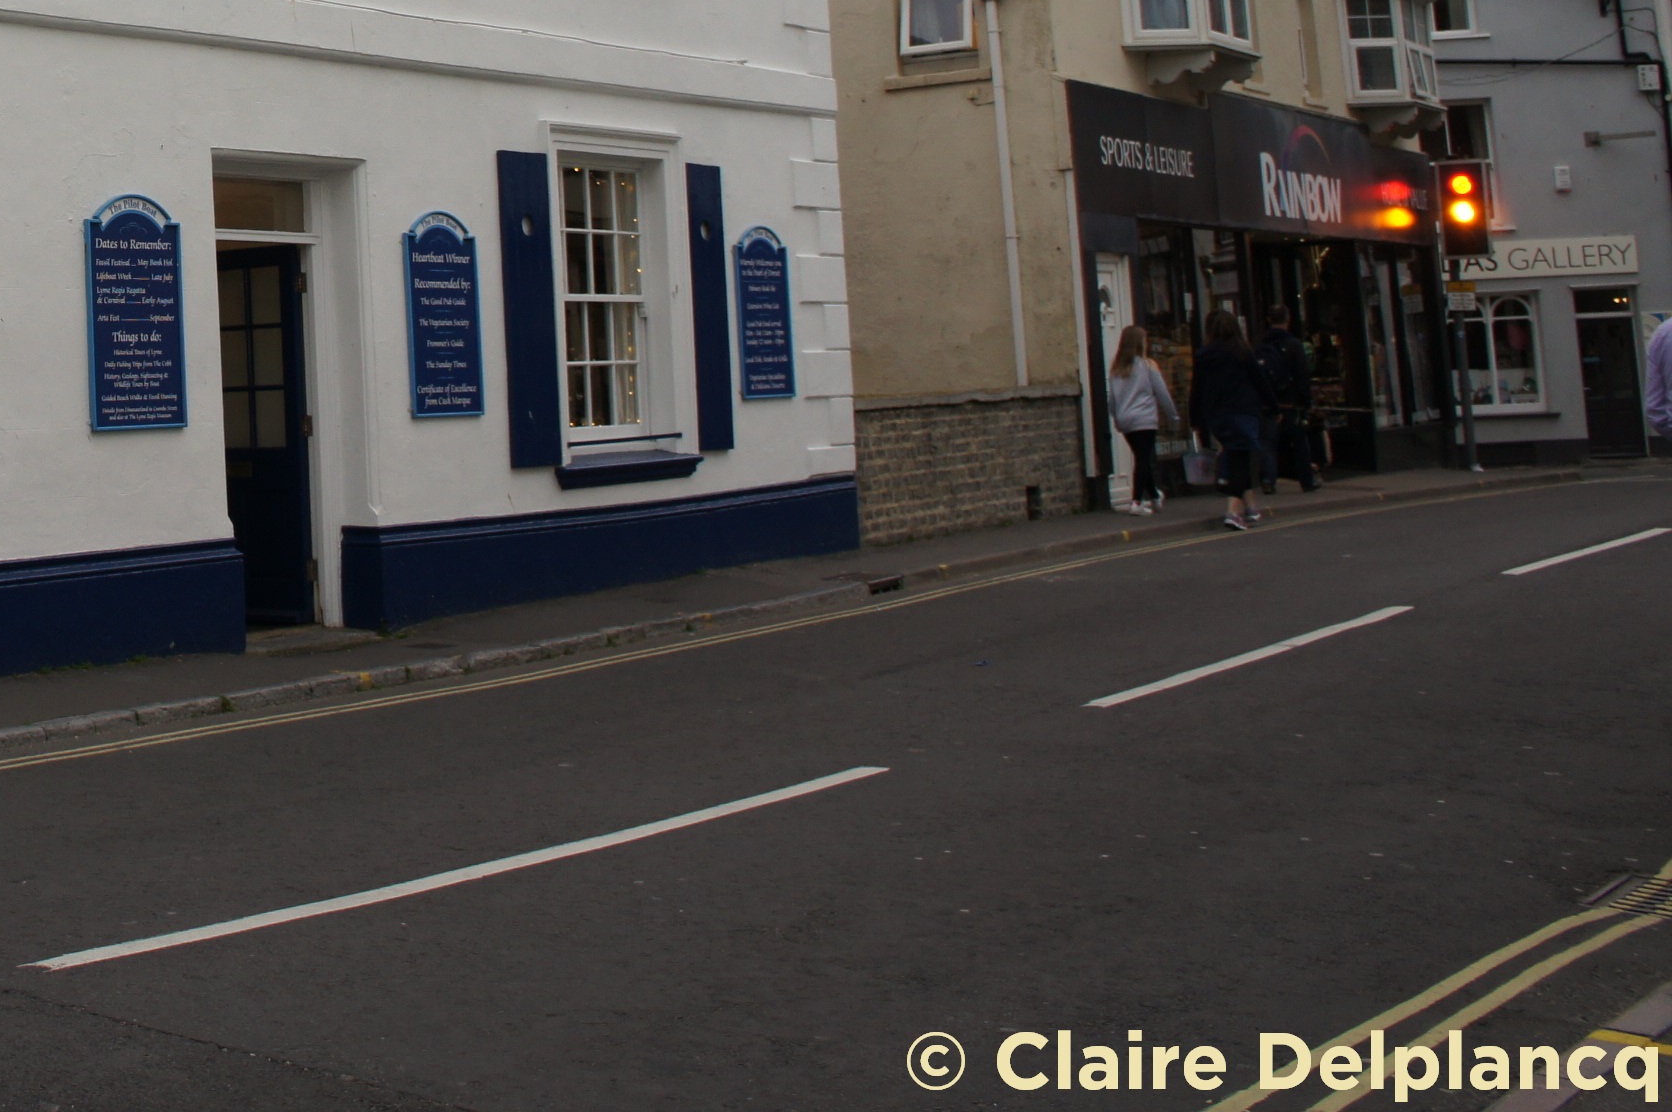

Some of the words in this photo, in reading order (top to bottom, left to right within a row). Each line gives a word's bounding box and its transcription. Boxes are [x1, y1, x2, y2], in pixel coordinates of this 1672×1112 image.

[1100, 134, 1143, 170] SPORTS
[1145, 143, 1154, 170] &
[1155, 143, 1194, 178] LEISURE
[108, 202, 123, 215] The
[123, 199, 140, 209] Pilot
[142, 201, 158, 216] Boat
[95, 237, 118, 249] Dates
[120, 240, 128, 249] to
[130, 238, 172, 251] Remember:
[1508, 242, 1631, 269] GALLERY
[112, 330, 138, 346] Things
[140, 332, 149, 342] to
[150, 329, 162, 342] do:
